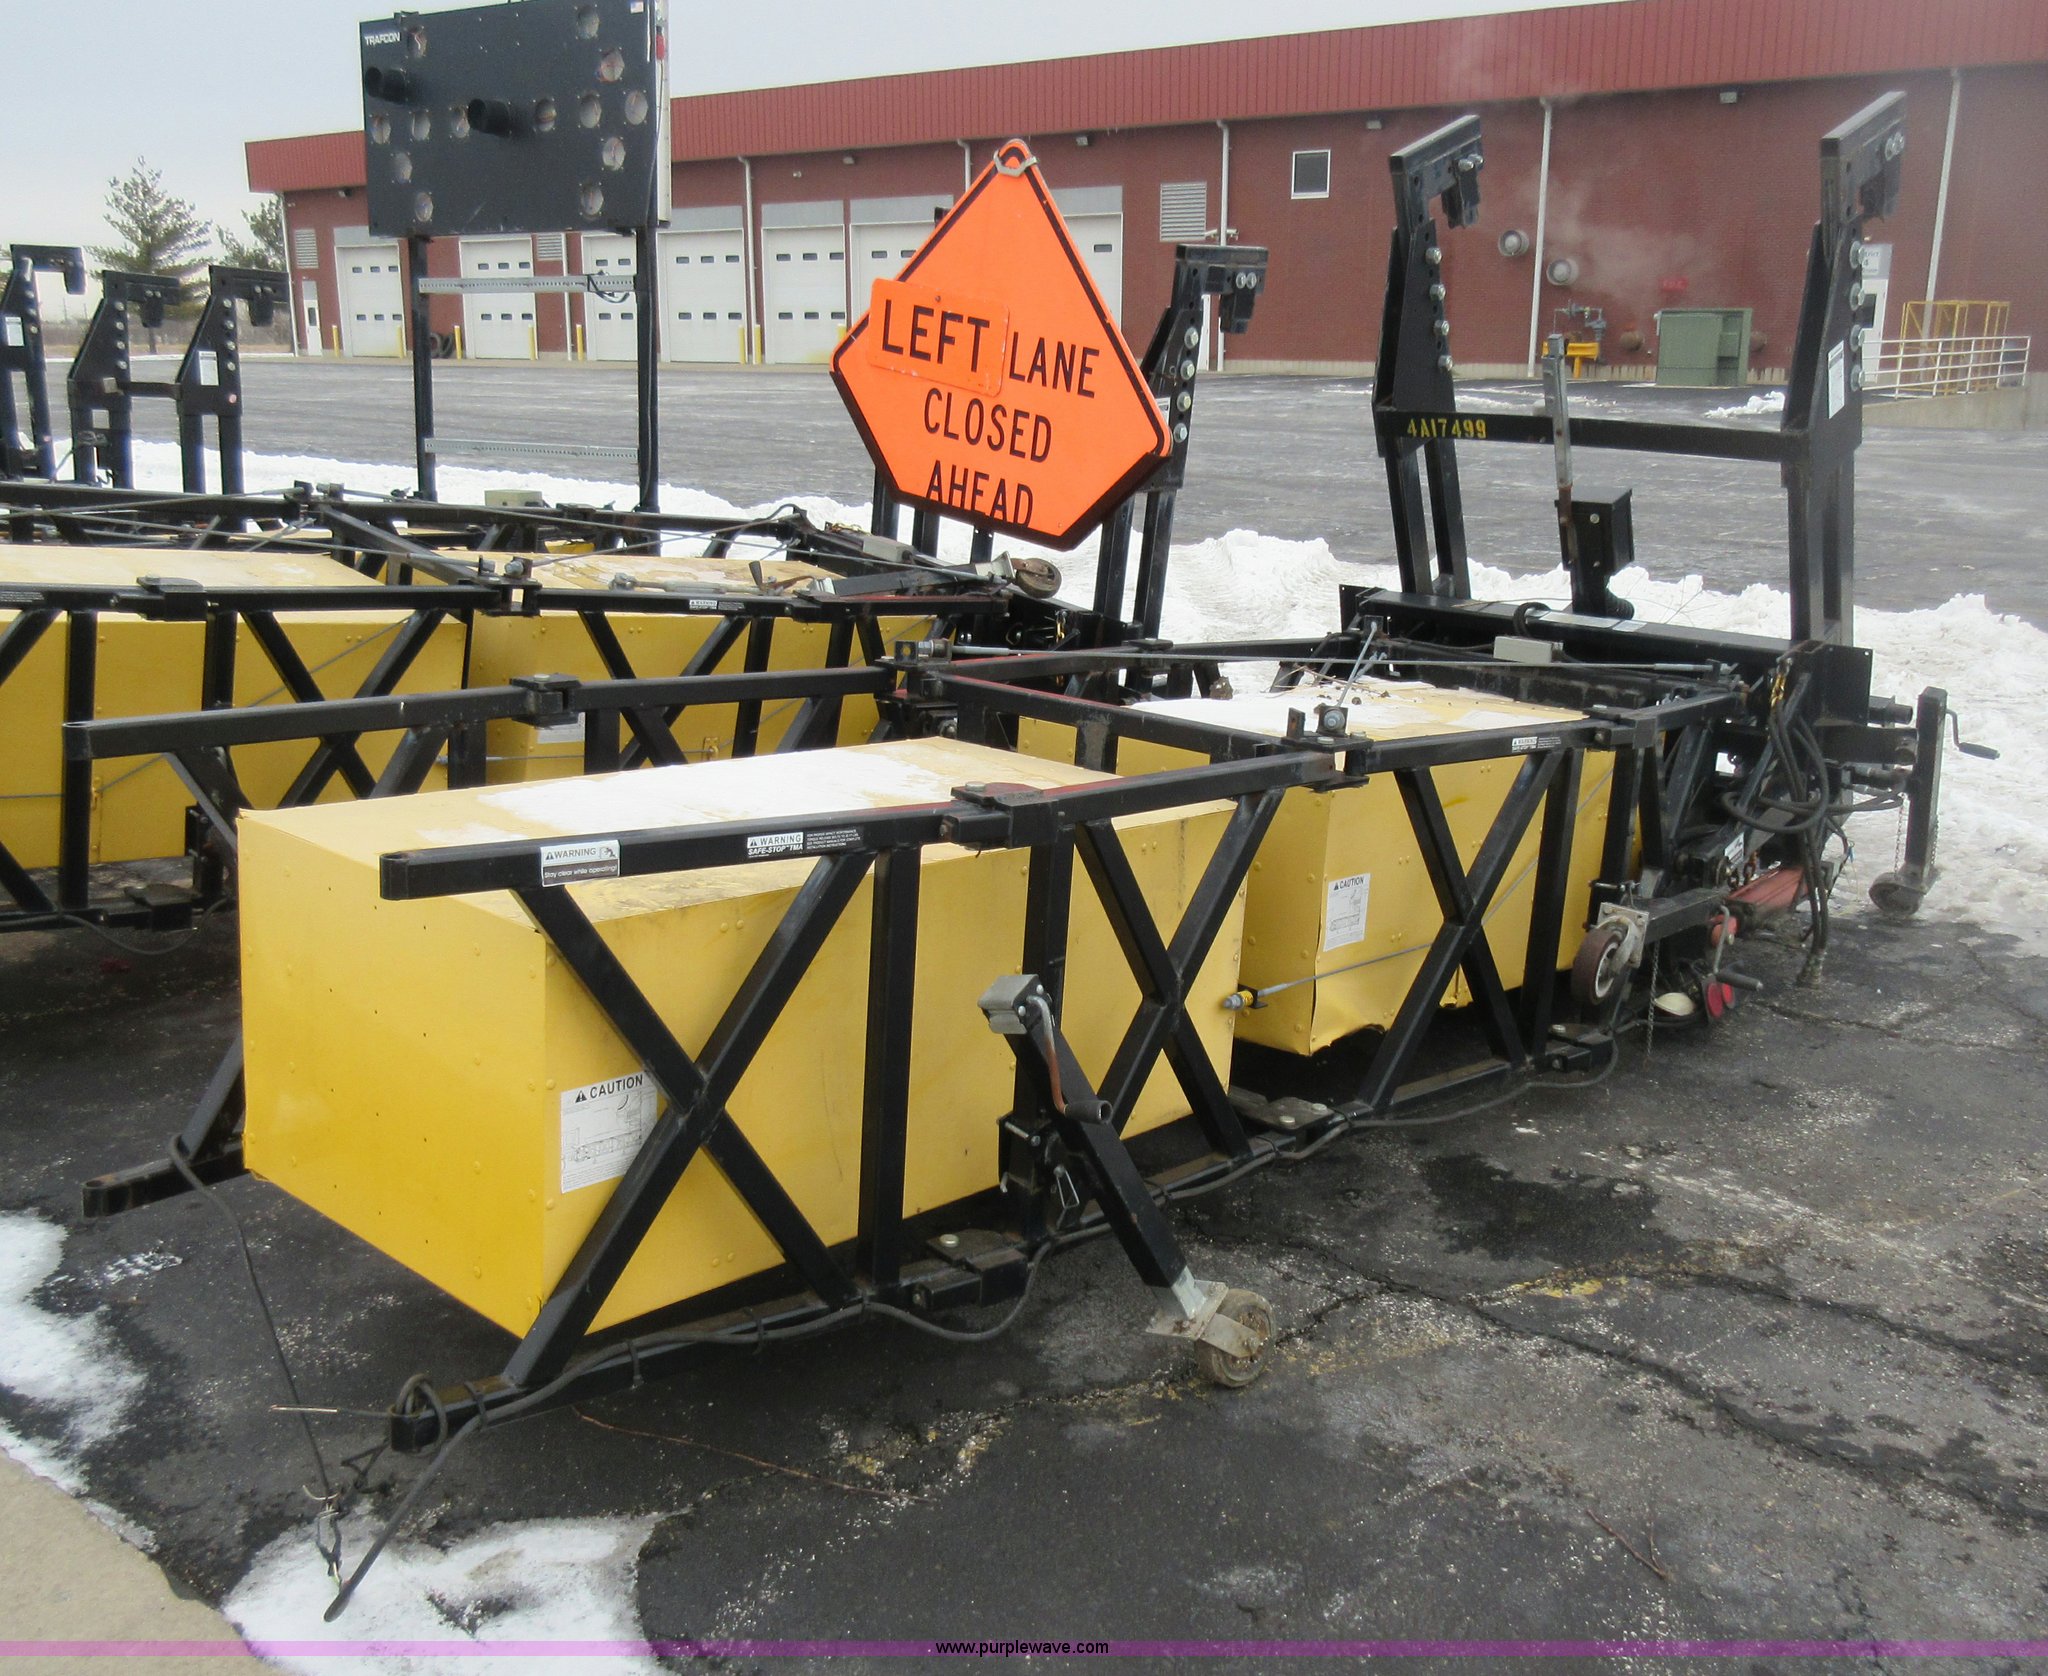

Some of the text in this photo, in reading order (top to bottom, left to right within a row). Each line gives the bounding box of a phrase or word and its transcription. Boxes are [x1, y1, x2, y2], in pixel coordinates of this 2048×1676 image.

[364, 32, 400, 45] TRAFCON
[881, 298, 1100, 399] LEFT LANE
[924, 387, 1052, 463] CLOSED
[1407, 418, 1486, 439] 4A17499
[925, 459, 1034, 529] AHEAD
[760, 834, 802, 846] WARNING
[554, 847, 597, 858] WARNING
[790, 843, 803, 851] TMA
[574, 867, 588, 875] while
[1340, 876, 1364, 889] CAUTION
[590, 1074, 643, 1099] CAUTION
